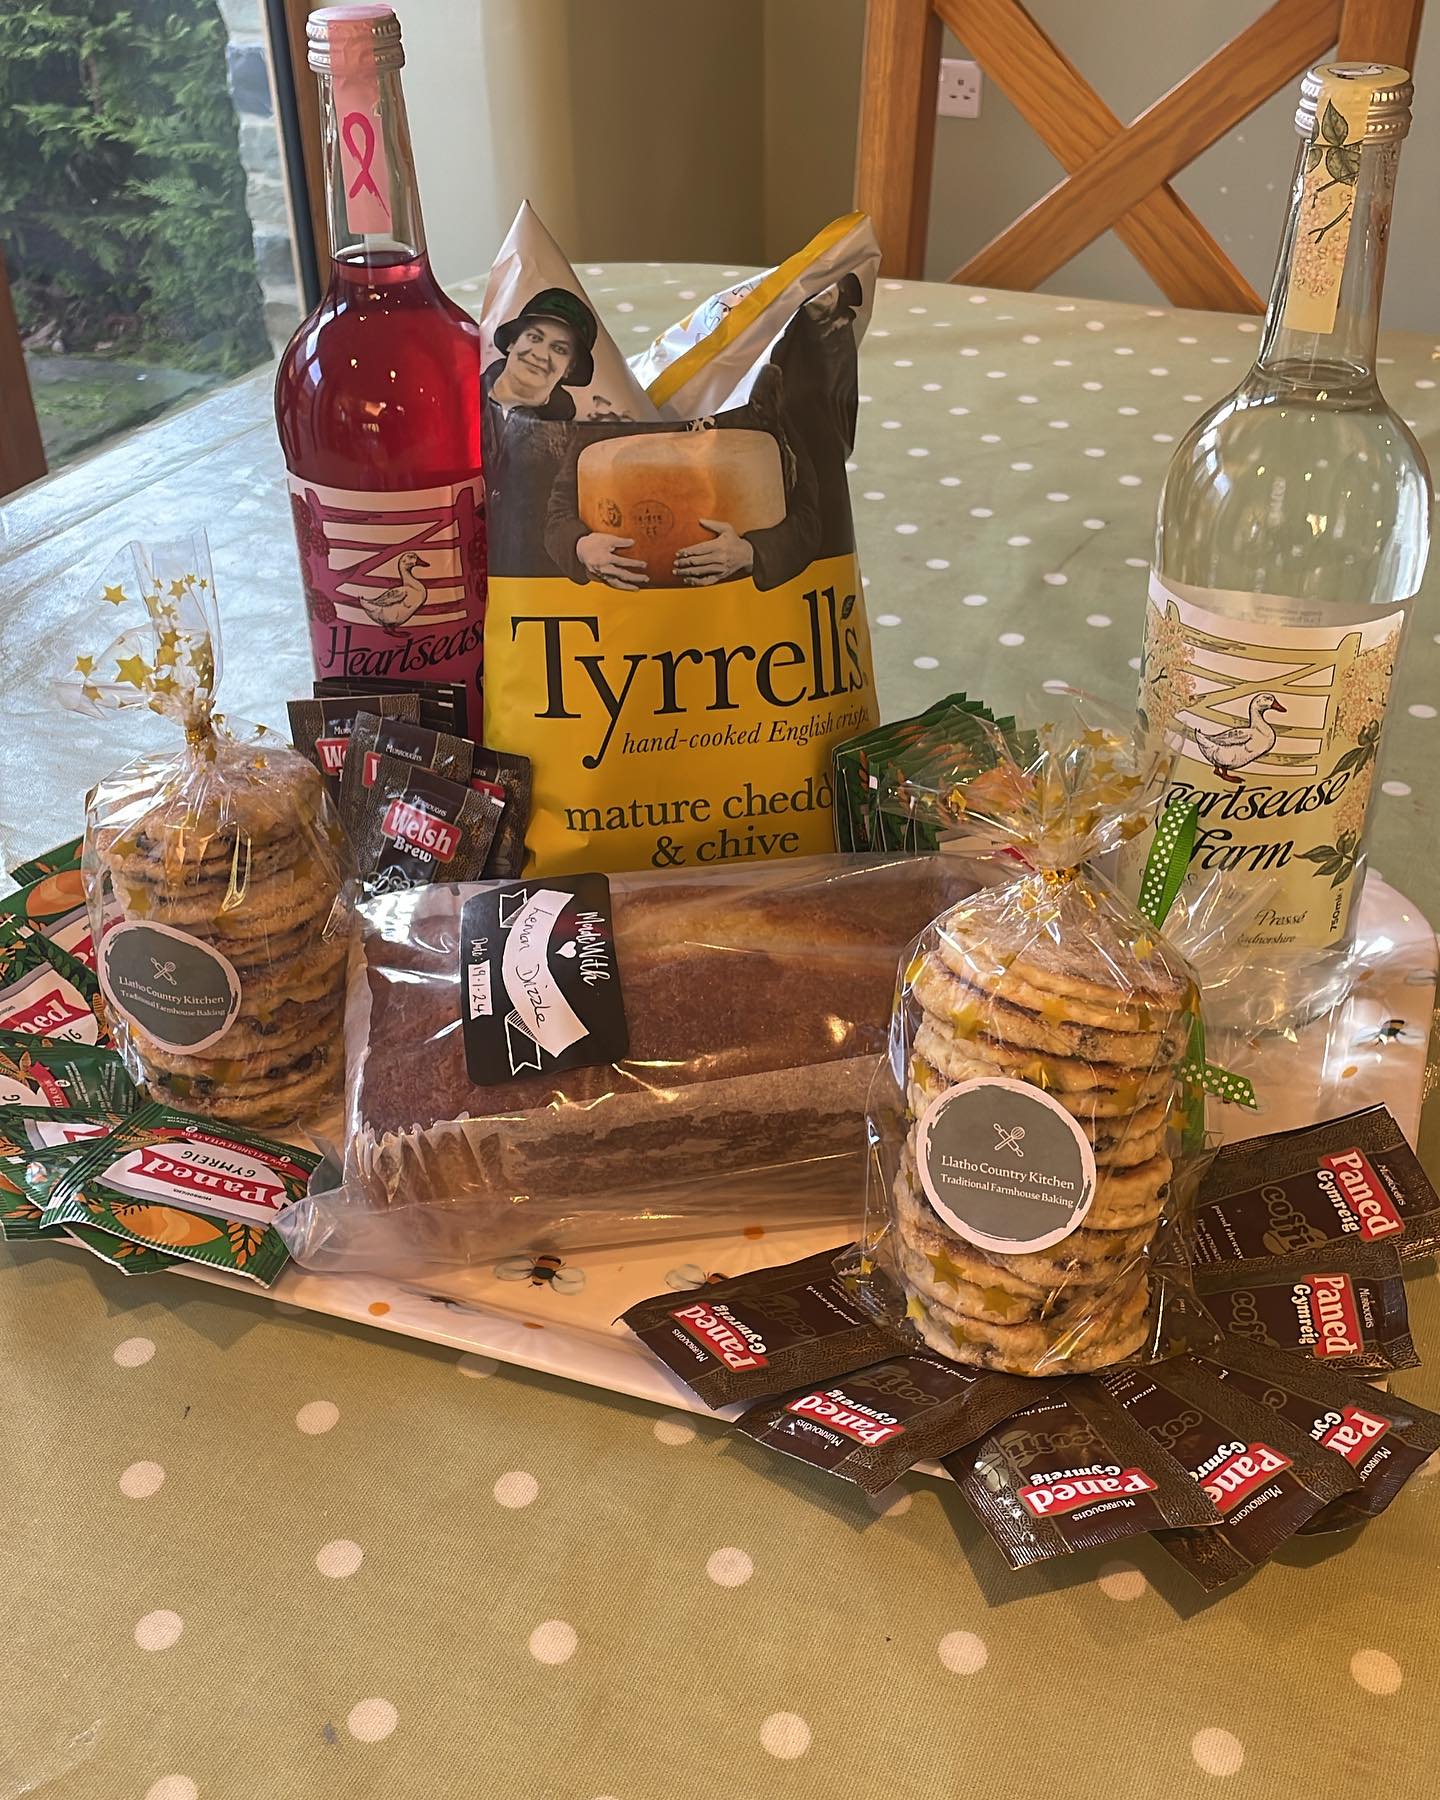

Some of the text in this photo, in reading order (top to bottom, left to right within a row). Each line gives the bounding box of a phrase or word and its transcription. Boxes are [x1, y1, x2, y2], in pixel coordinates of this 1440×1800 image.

[318, 619, 484, 677] Heartseas
[622, 722, 760, 754] hand-cooked
[768, 712, 832, 746] English
[564, 775, 835, 832] mature chedd
[390, 805, 452, 855] Welsh
[392, 836, 432, 863] Brew
[651, 829, 800, 868] & chive
[1190, 829, 1294, 872] Farm
[13, 999, 73, 1034] ned
[146, 986, 182, 1004] Country
[183, 995, 224, 1006] Kitchen
[142, 1157, 270, 1203] Paned
[181, 1150, 256, 1178] GYMREIG
[941, 1155, 1075, 1190] Llatho Country Kitchen
[940, 1173, 1074, 1209] Traditional Farmhouse Baking
[1316, 1170, 1360, 1233] Gymreig
[1330, 1151, 1400, 1236] Paned
[711, 1304, 767, 1354] Gymreig
[1291, 1284, 1320, 1345] Gymreig
[1314, 1276, 1358, 1354] Paned
[674, 1304, 757, 1371] Paned
[790, 1394, 896, 1445] Paned
[825, 1389, 898, 1425] Gymreig
[1029, 1464, 1121, 1487] Gymreig
[1203, 1448, 1286, 1503] Pane
[1359, 1446, 1392, 1482] MURROU
[1024, 1474, 1151, 1514] Paned
